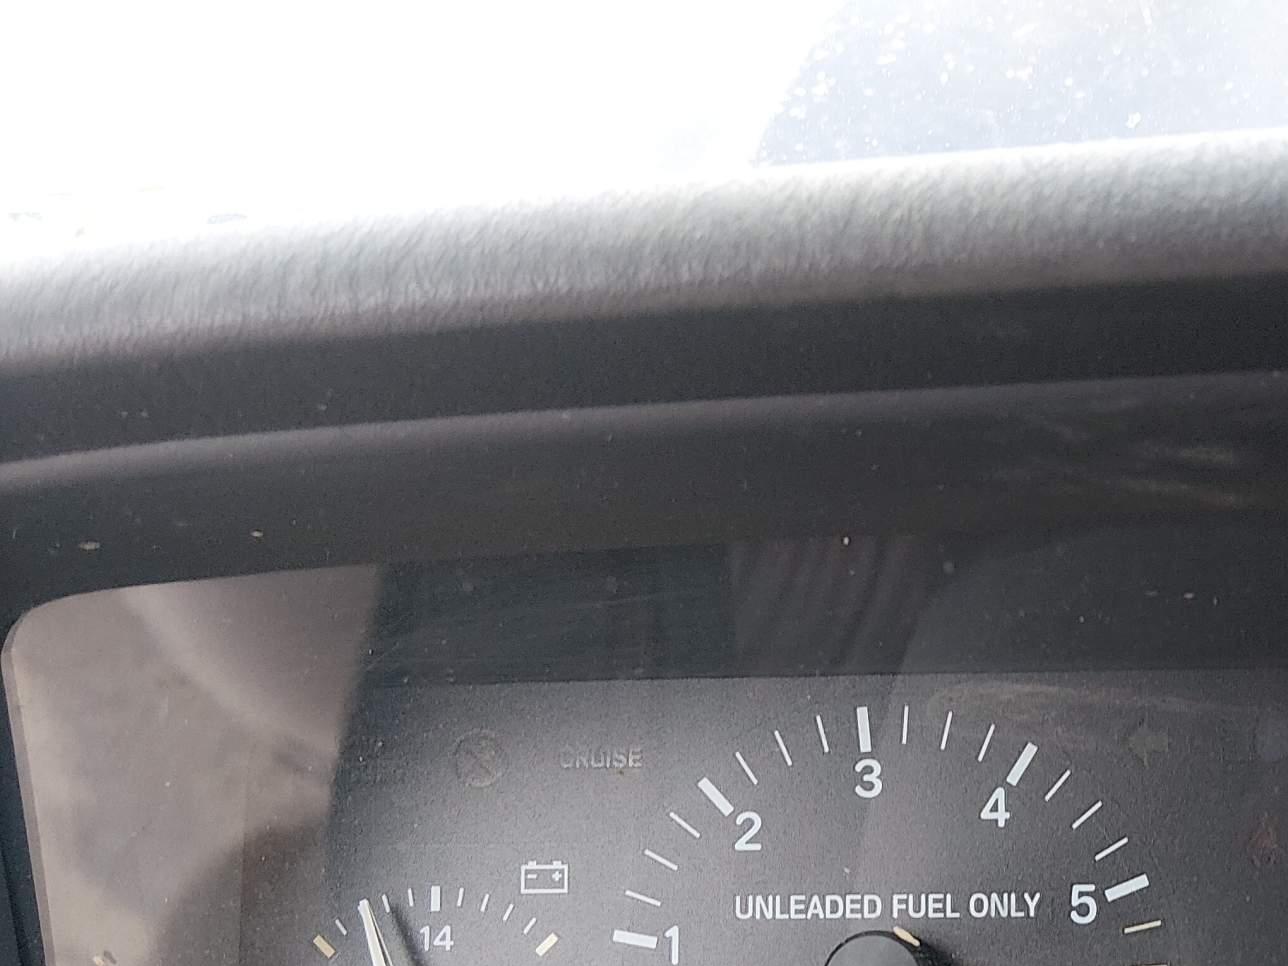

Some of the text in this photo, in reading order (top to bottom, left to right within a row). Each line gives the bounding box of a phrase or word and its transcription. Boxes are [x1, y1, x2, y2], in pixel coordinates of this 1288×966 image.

[854, 758, 883, 798] 3
[981, 787, 1010, 827] 4
[733, 811, 763, 851] 2
[734, 893, 1041, 918] UNLEADED FUEL ONLY
[1070, 884, 1097, 924] 5
[419, 925, 454, 951] 14
[663, 926, 679, 965] 1
